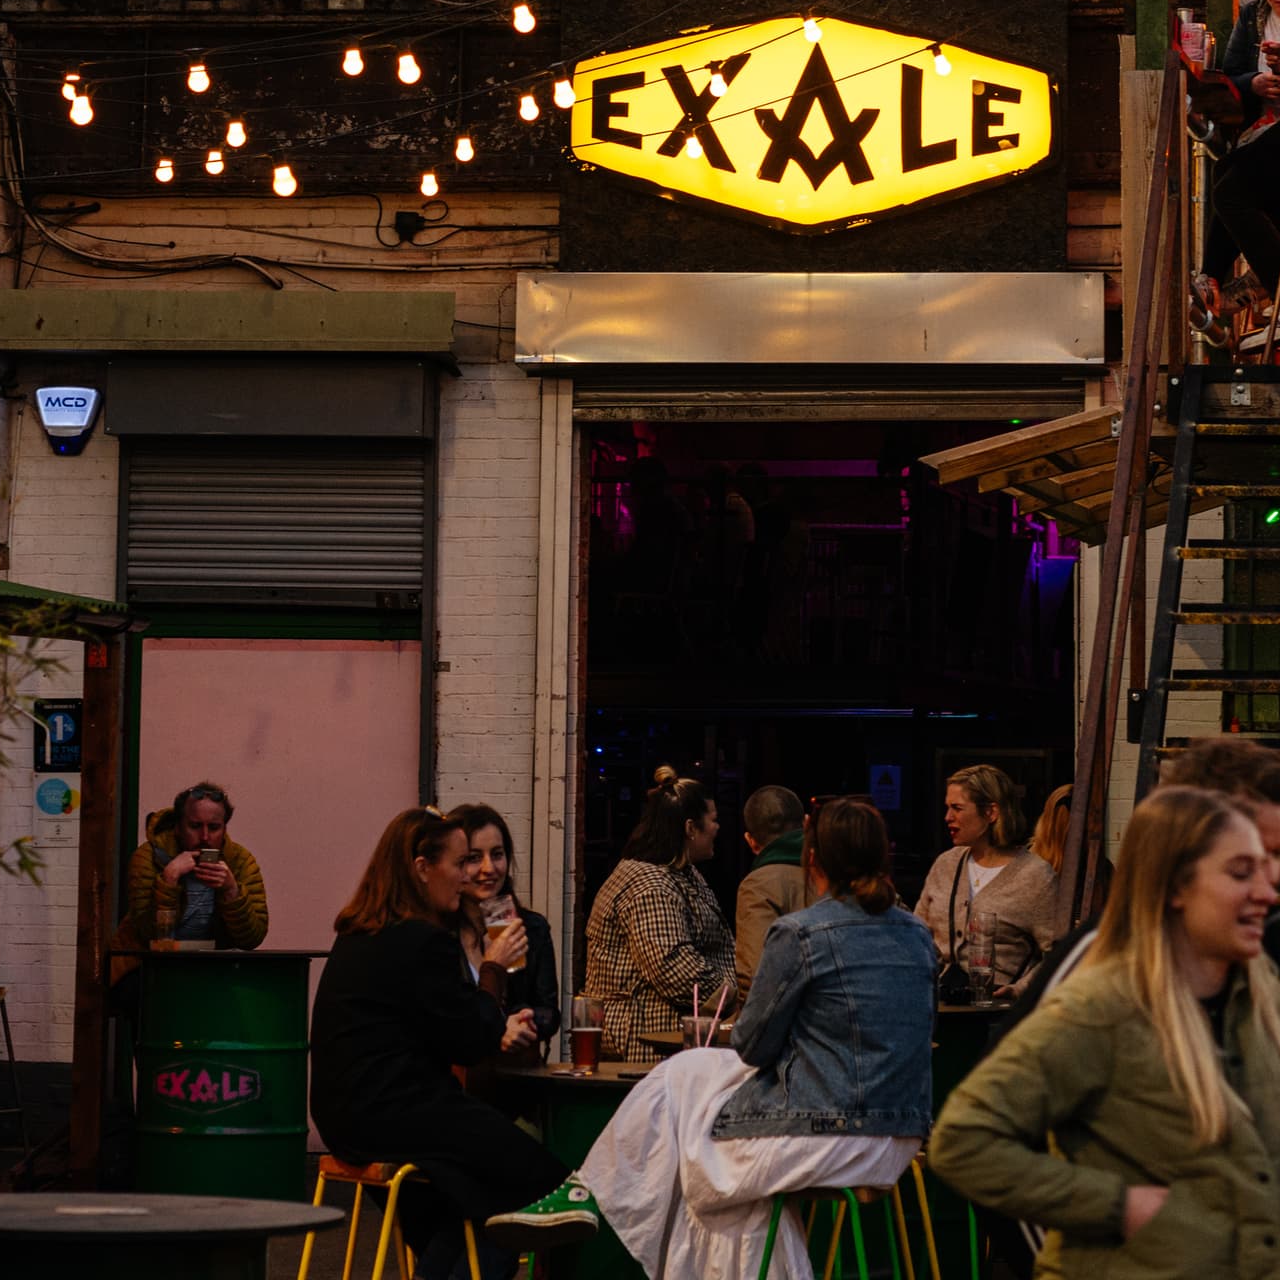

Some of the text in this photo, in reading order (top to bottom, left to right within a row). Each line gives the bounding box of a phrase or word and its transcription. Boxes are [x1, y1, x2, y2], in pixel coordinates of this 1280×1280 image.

[592, 42, 1021, 191] EXALE
[45, 397, 87, 407] MCD
[157, 1069, 253, 1103] EXALE
